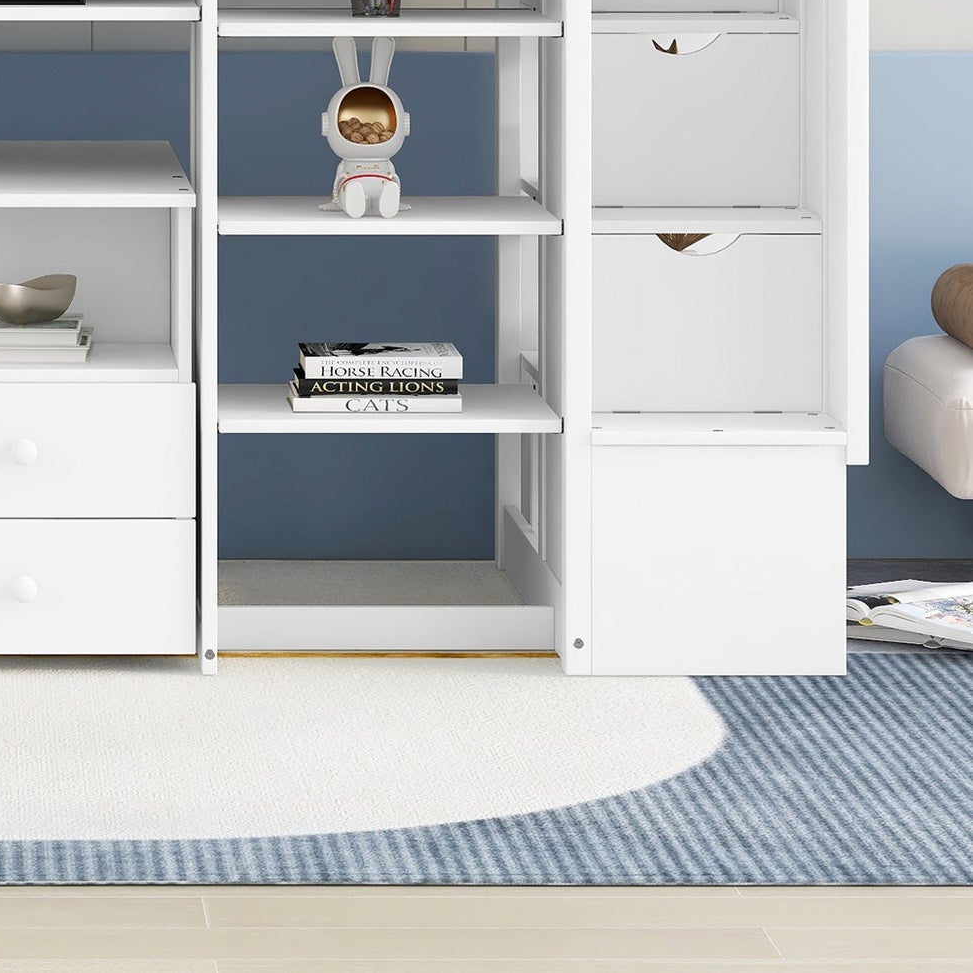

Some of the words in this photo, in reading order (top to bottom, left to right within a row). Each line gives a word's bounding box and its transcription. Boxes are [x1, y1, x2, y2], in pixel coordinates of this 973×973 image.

[321, 366, 375, 377] HORSE
[380, 366, 442, 378] RACING
[311, 381, 383, 393] ACTING
[389, 381, 444, 393] LIONS
[345, 399, 409, 412] CATS
